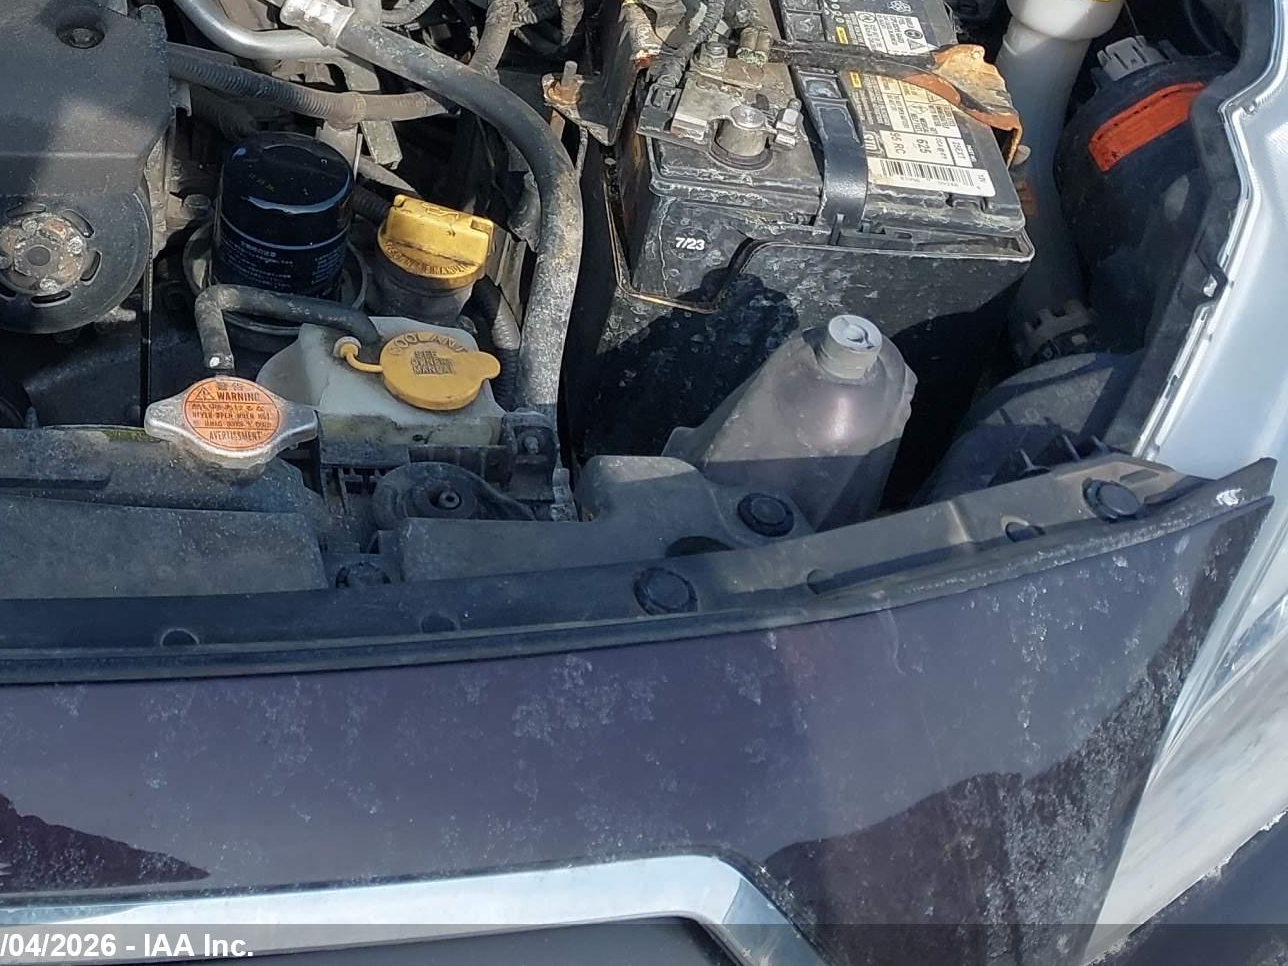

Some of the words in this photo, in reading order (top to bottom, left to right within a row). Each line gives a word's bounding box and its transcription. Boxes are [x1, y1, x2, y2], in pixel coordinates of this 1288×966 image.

[895, 143, 907, 156] RC
[916, 137, 932, 155] 625
[675, 236, 705, 251] 7/23
[388, 333, 469, 354] COOLANT
[217, 391, 261, 402] WARNING
